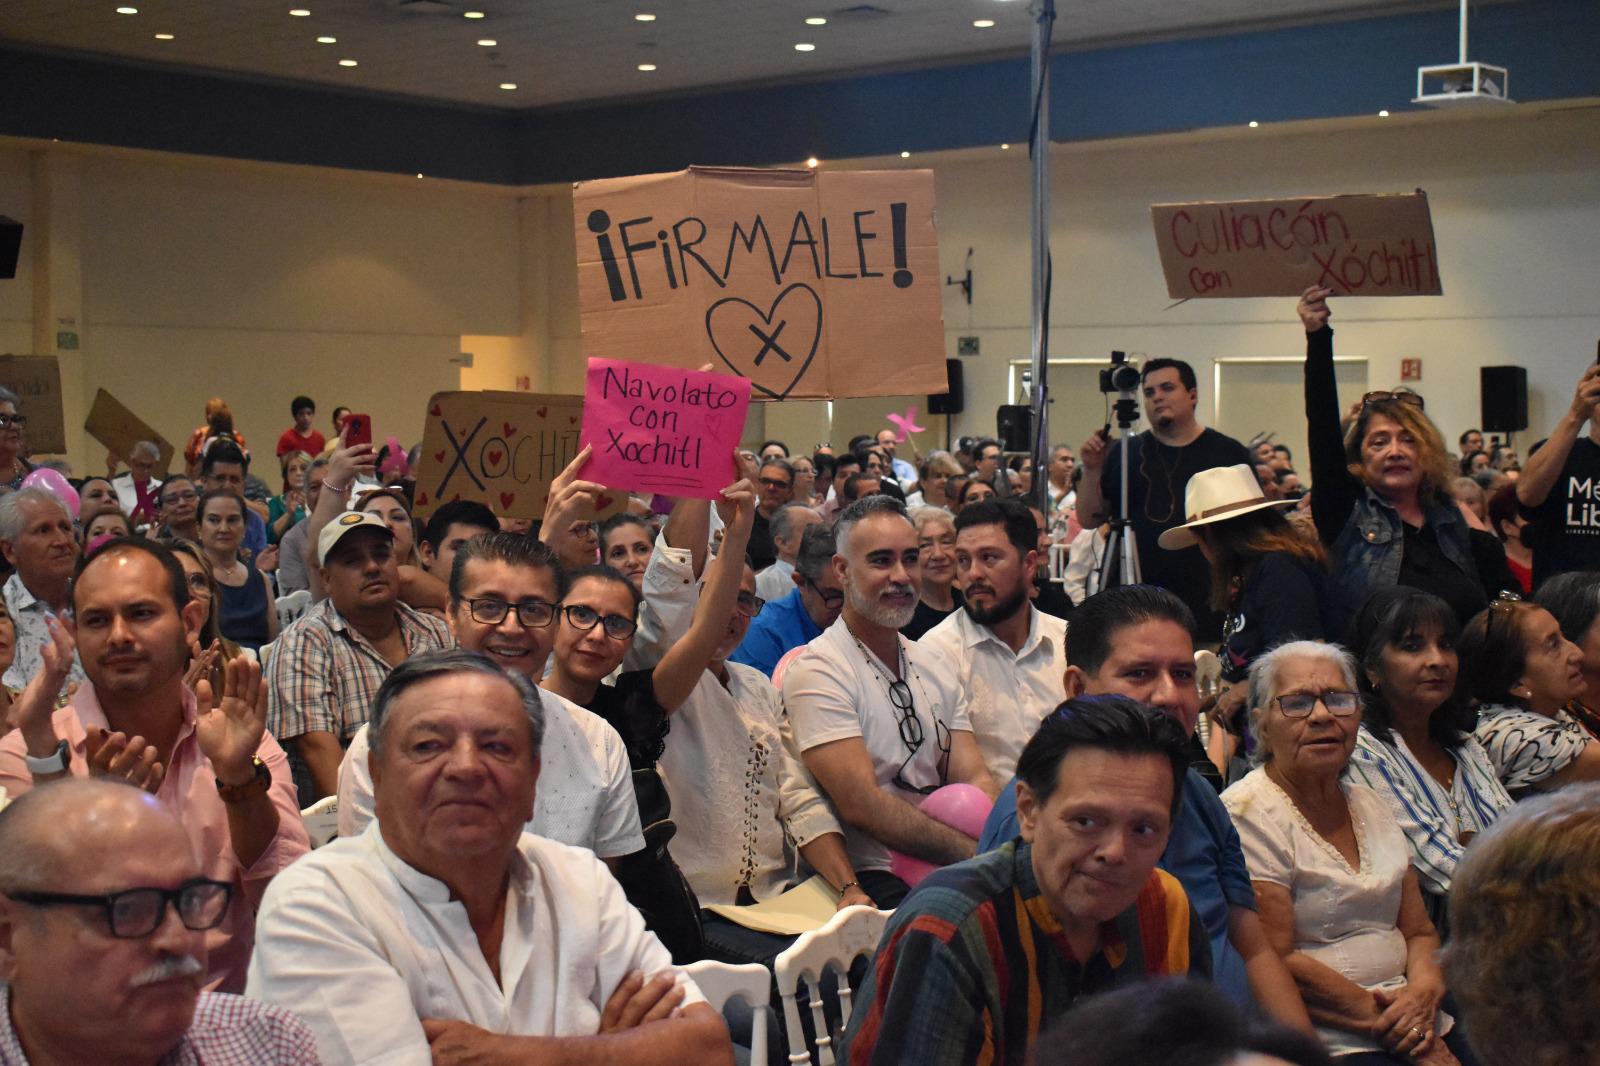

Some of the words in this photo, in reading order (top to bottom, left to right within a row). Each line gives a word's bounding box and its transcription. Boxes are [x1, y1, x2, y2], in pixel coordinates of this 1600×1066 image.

[1312, 238, 1436, 293] Xóchitl
[603, 366, 737, 410] Navolato
[435, 415, 582, 500] XOCHIT
